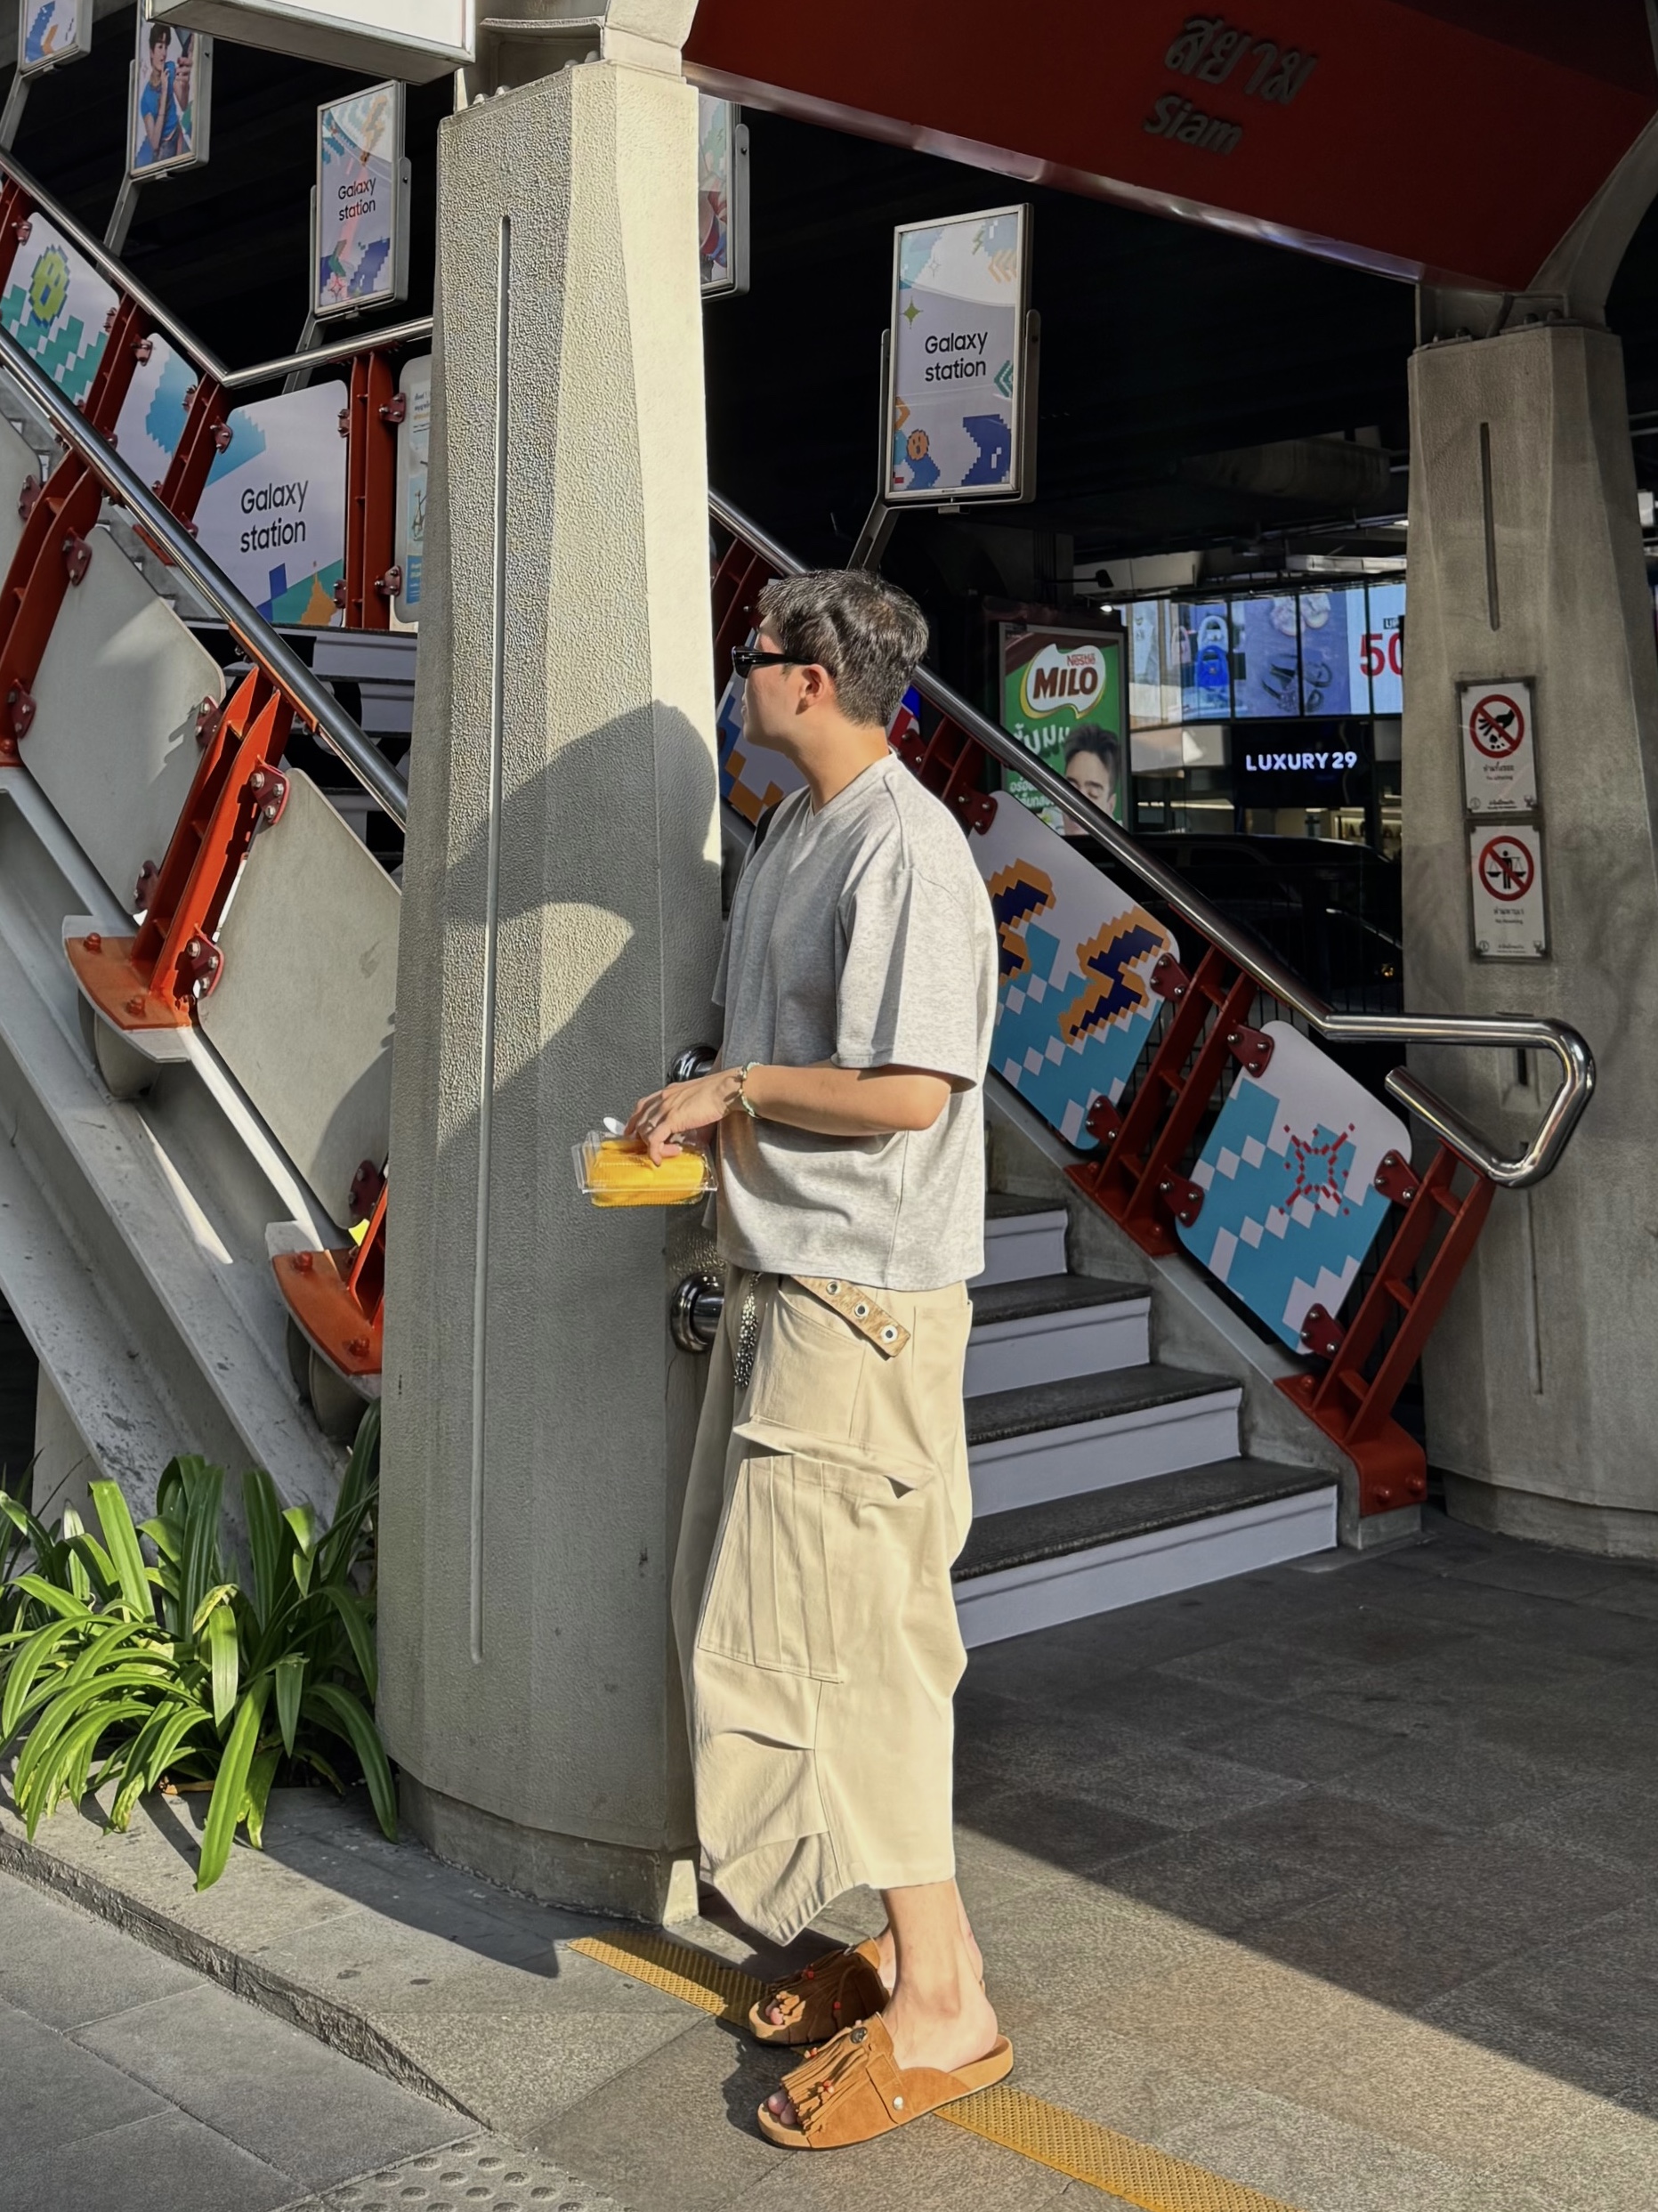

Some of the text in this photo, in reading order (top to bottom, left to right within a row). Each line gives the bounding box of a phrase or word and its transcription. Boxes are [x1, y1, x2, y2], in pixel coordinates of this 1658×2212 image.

[1164, 17, 1318, 105] สยาม
[1143, 93, 1243, 156] Siam
[338, 177, 376, 200] Galaxy
[338, 199, 376, 222] station
[925, 331, 988, 355] Galaxy
[925, 357, 987, 383] station
[240, 480, 309, 515] Galaxy
[239, 517, 307, 554] station
[1032, 666, 1099, 701] MILO
[1245, 750, 1358, 772] LUXURY 29
